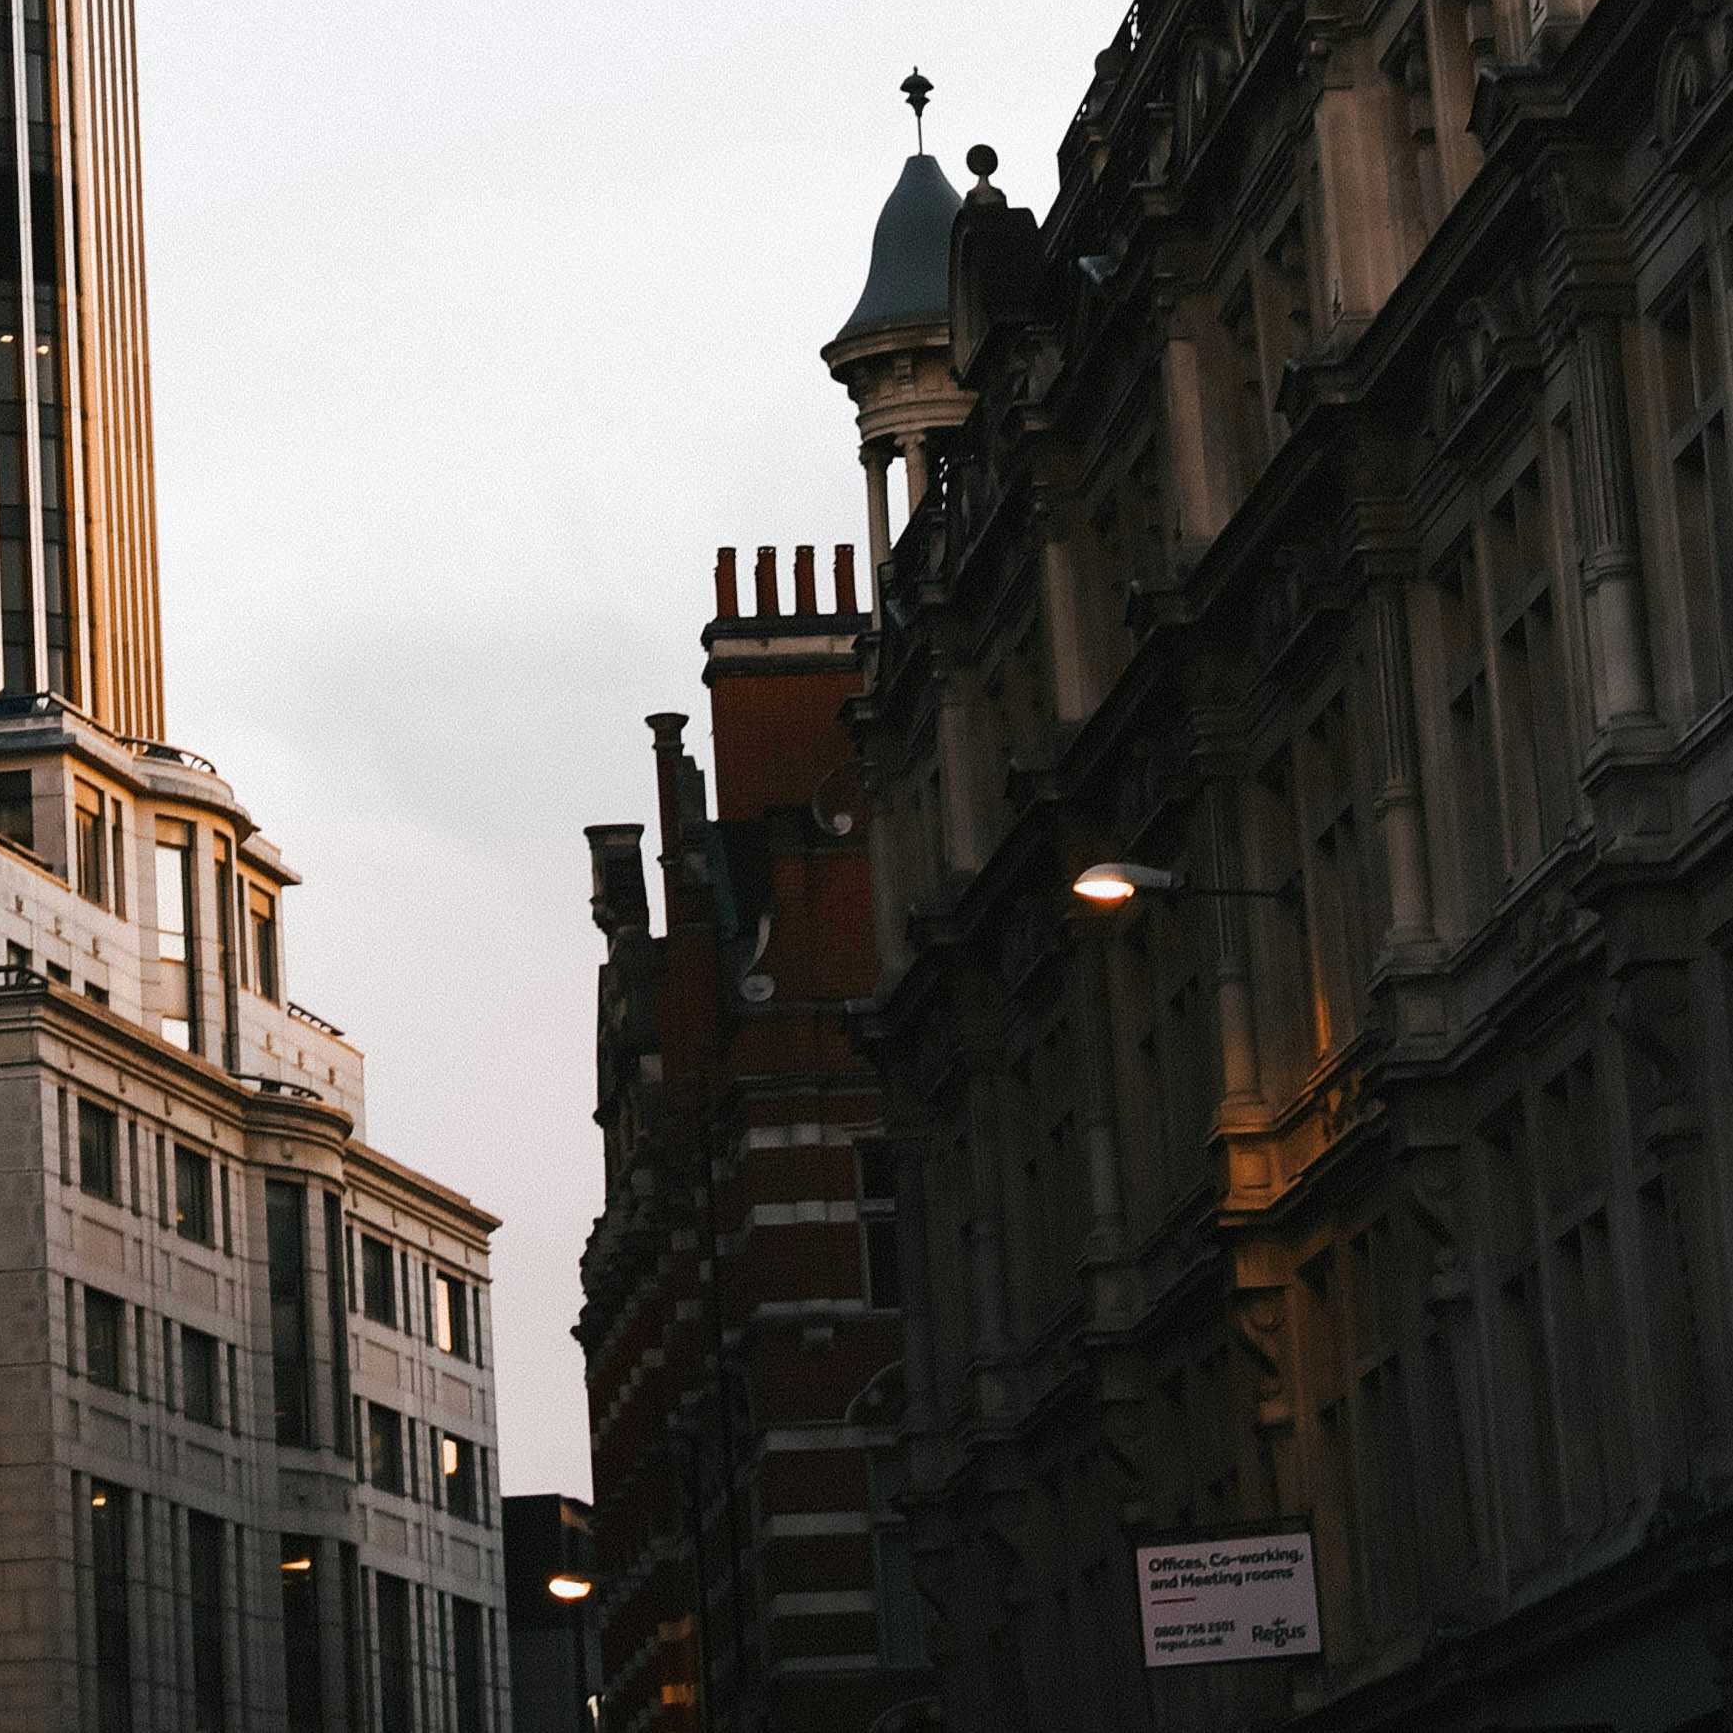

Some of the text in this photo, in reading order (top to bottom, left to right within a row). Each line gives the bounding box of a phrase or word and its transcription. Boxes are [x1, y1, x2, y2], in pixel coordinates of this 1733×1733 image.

[1149, 1548, 1304, 1572] Offices, Co-working,
[1151, 1567, 1294, 1591] and Meeting rooms
[1252, 1624, 1307, 1648] Regus
